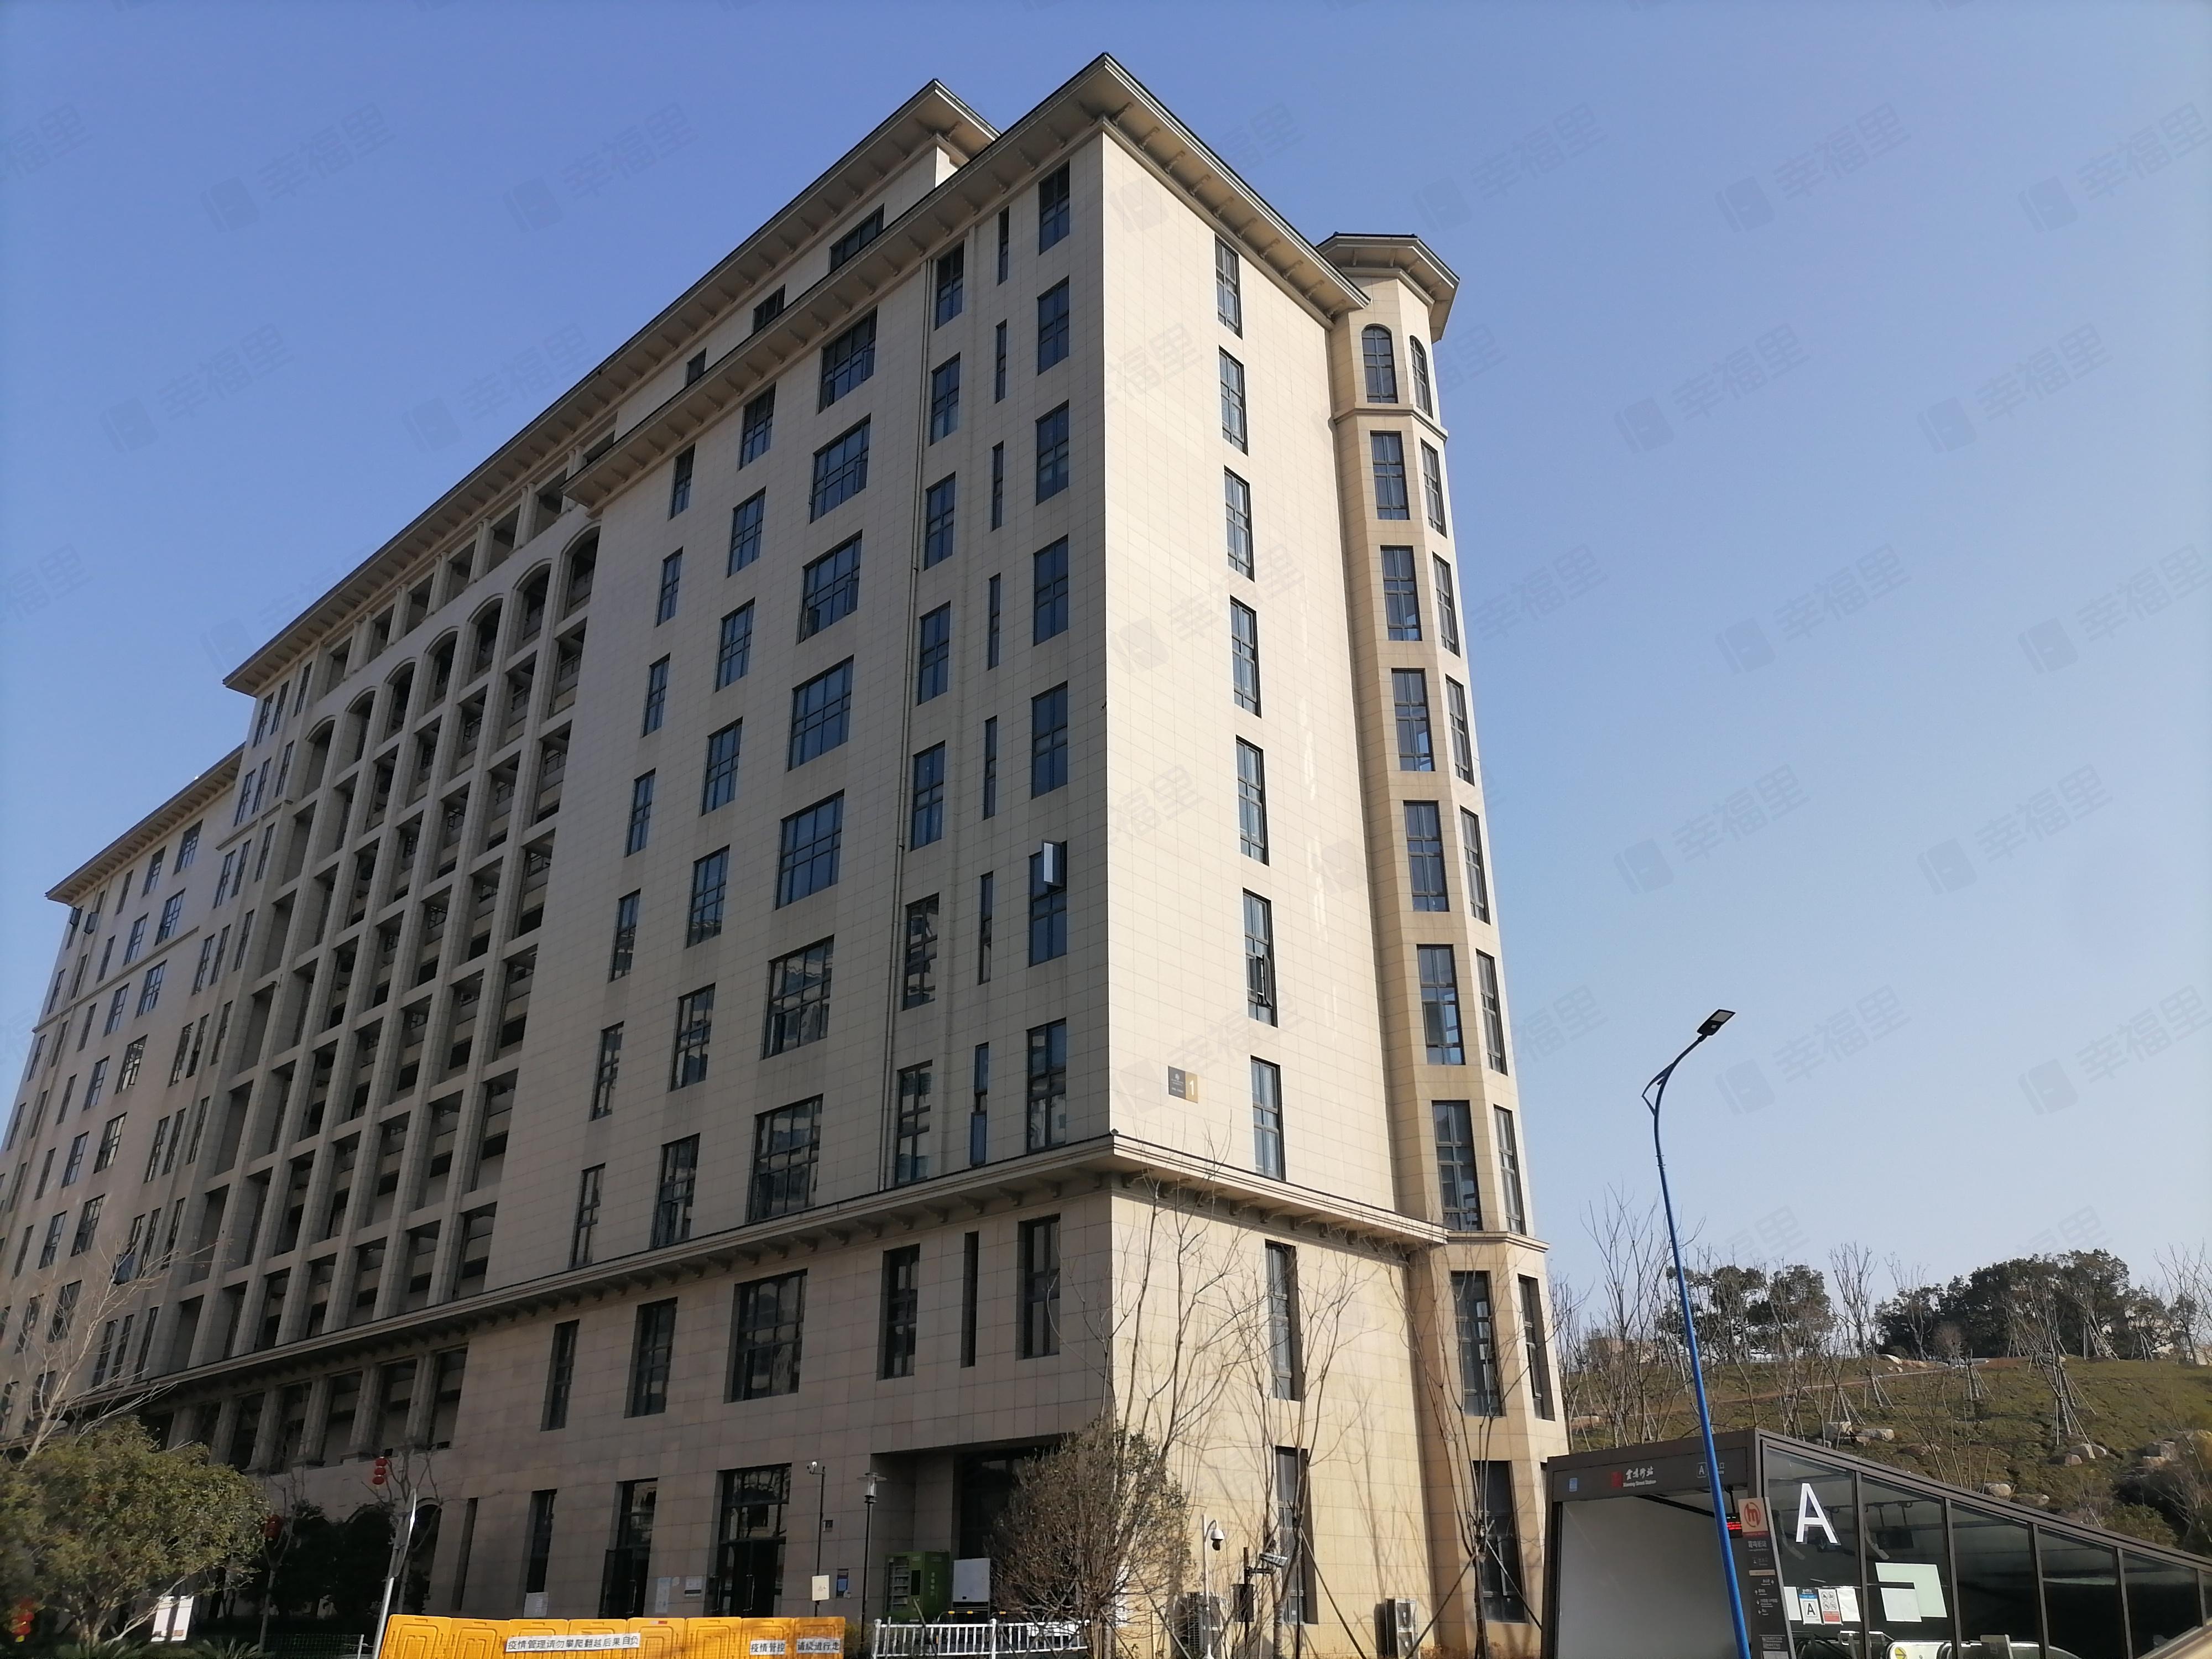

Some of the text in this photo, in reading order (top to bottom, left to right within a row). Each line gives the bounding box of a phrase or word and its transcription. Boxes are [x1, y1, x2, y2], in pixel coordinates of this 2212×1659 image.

[1189, 1079, 1194, 1096] 1
[1698, 1465, 1705, 1475] A
[1796, 1483, 1838, 1545] A
[1807, 1603, 1816, 1615] A
[508, 1635, 638, 1650] 疫情管理请勿攀爬翻越后果自负
[751, 1642, 786, 1653] 疫情管控
